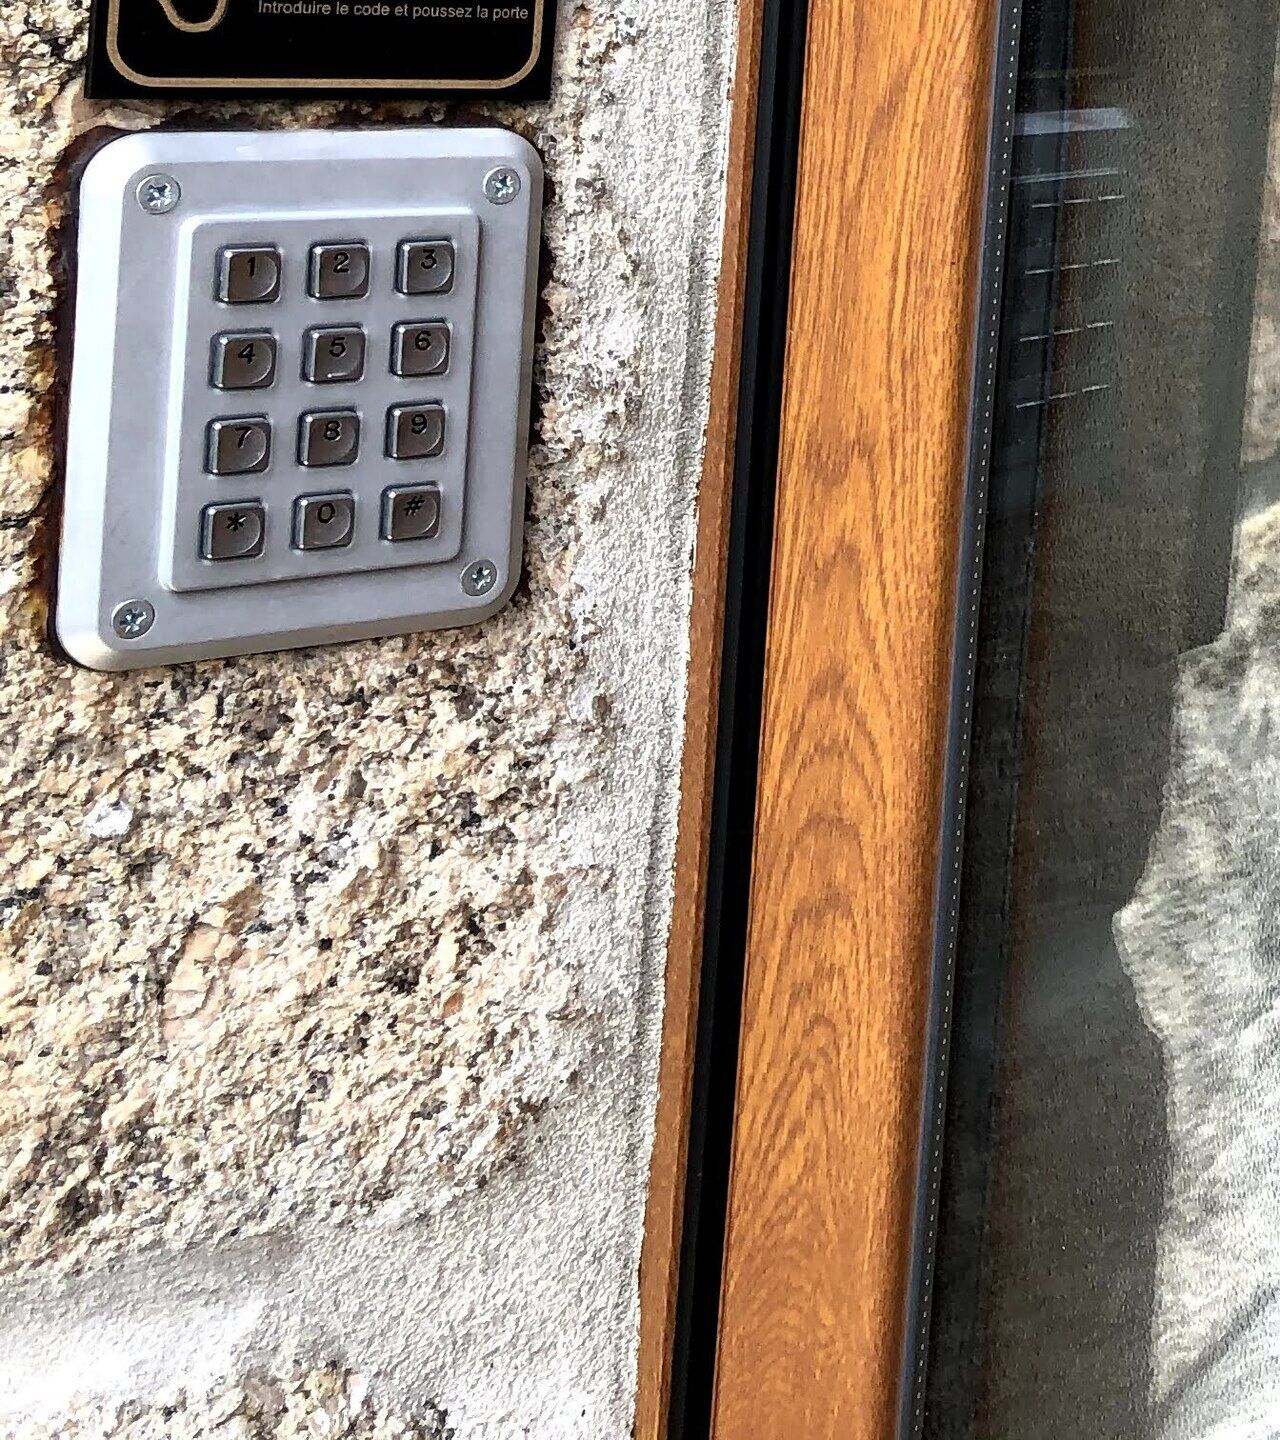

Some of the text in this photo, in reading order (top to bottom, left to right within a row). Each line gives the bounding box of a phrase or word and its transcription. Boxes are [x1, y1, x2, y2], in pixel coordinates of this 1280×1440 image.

[257, 0, 529, 21] Introduire le code et poussez la porte
[247, 249, 437, 278] 1 2 3
[237, 330, 431, 364] 4 5 6
[235, 413, 428, 448] 7 8 9
[317, 502, 336, 524] 0
